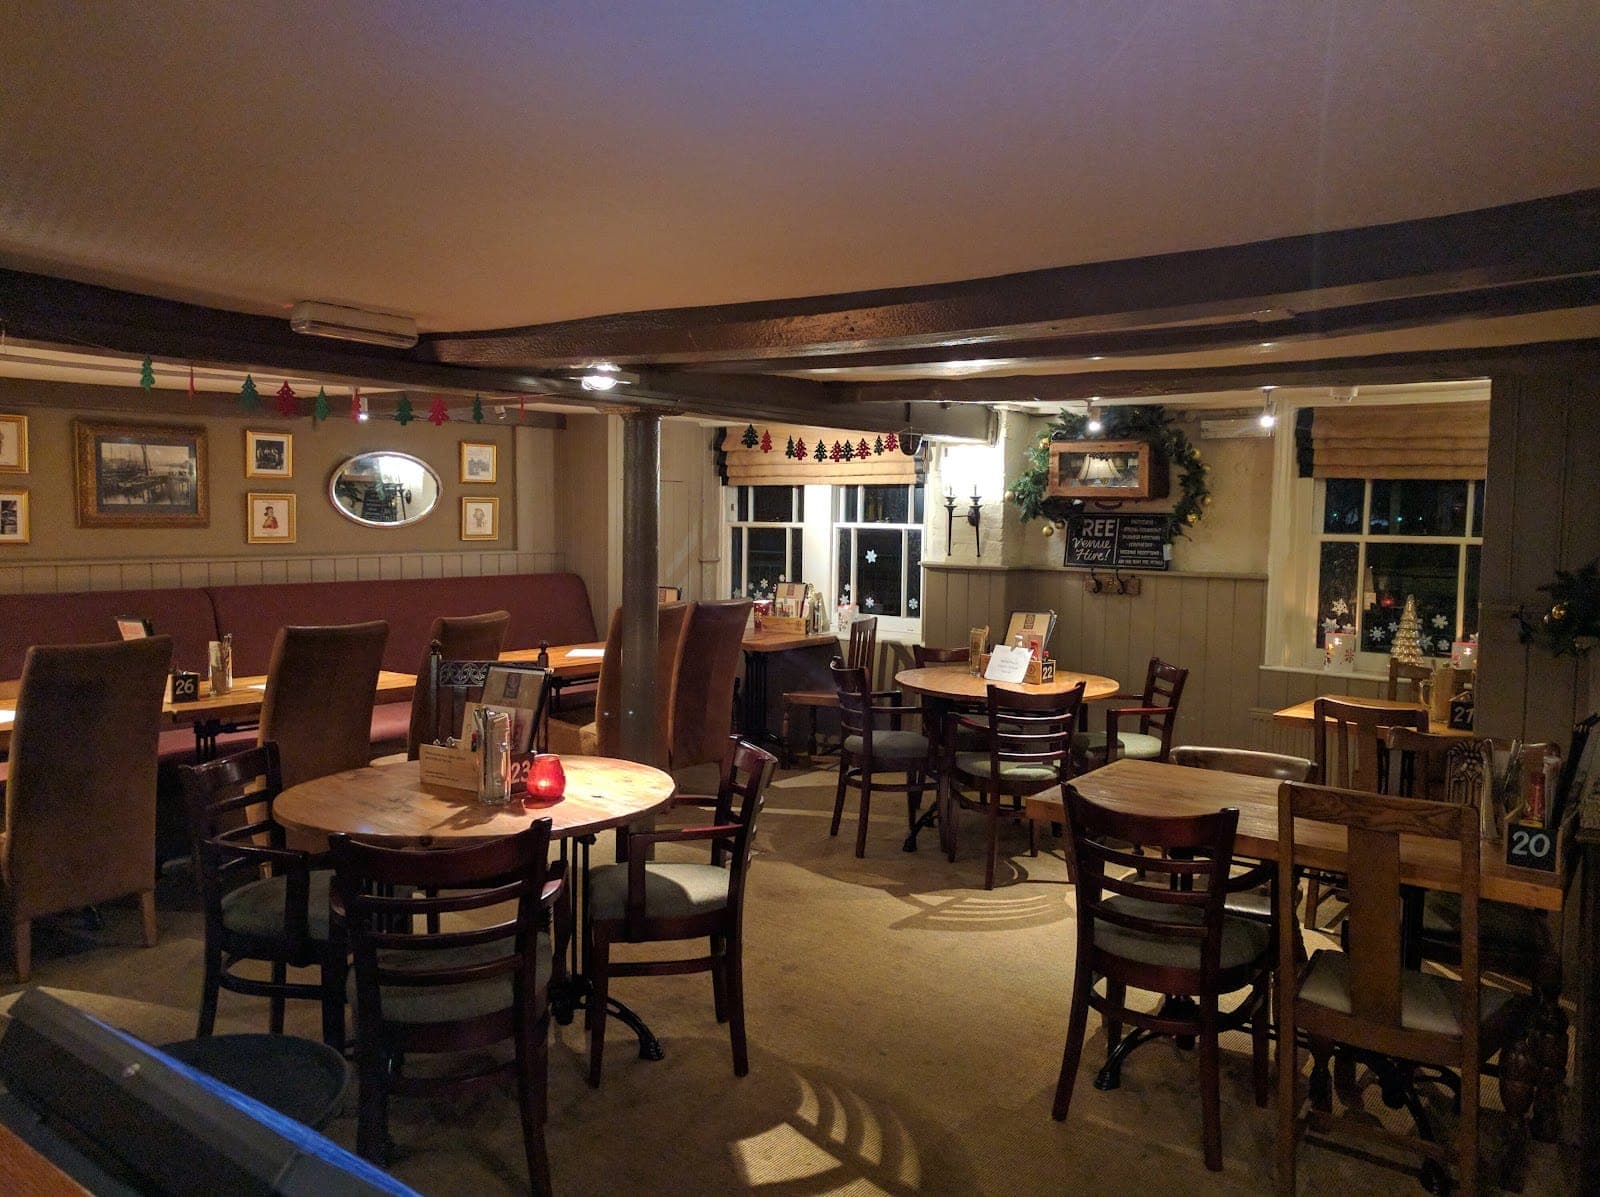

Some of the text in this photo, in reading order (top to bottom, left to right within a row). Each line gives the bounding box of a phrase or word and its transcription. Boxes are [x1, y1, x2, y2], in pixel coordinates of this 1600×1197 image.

[1082, 519, 1116, 537] REE
[1072, 537, 1111, 549] Venue
[1075, 548, 1111, 561] Hire!
[1042, 666, 1053, 680] 22
[175, 679, 195, 695] 26
[511, 760, 531, 784] 23
[1512, 830, 1551, 858] 20
